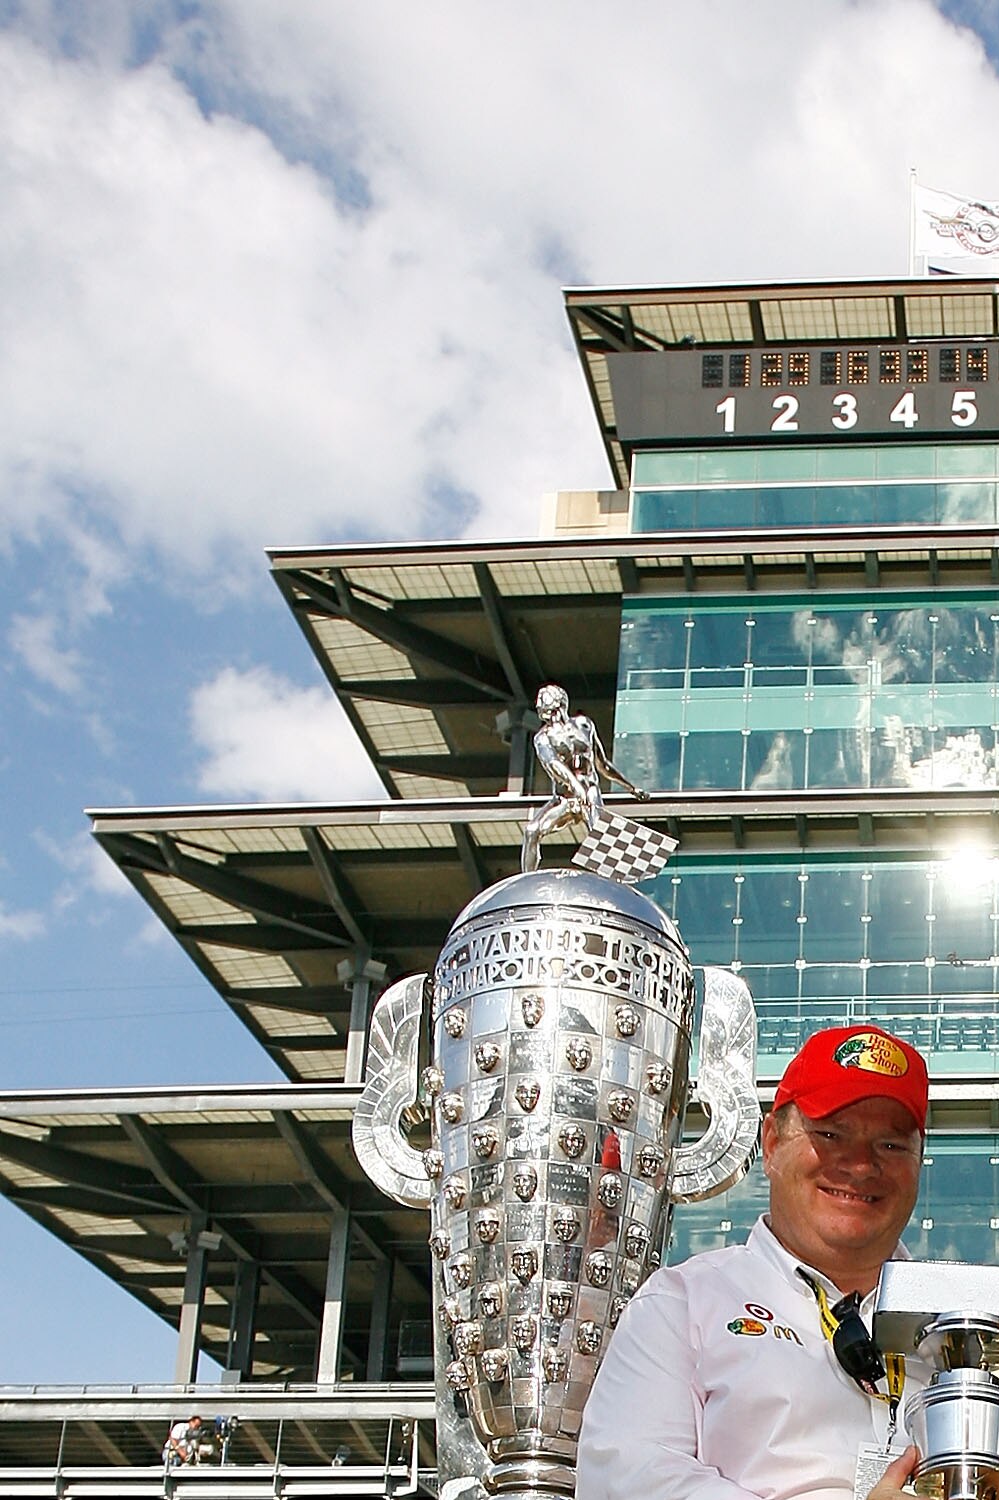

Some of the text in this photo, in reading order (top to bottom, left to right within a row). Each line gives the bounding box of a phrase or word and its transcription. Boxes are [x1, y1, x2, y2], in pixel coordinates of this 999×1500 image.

[761, 352, 810, 387] 29
[834, 351, 870, 385] 16
[879, 350, 928, 384] 33
[954, 349, 988, 382] 14
[715, 396, 736, 433] 1
[771, 394, 800, 432] 2
[831, 392, 858, 430] 3
[890, 391, 919, 428] 4
[950, 390, 978, 427] 5
[868, 1034, 899, 1052] Bass
[869, 1043, 892, 1059] Pro
